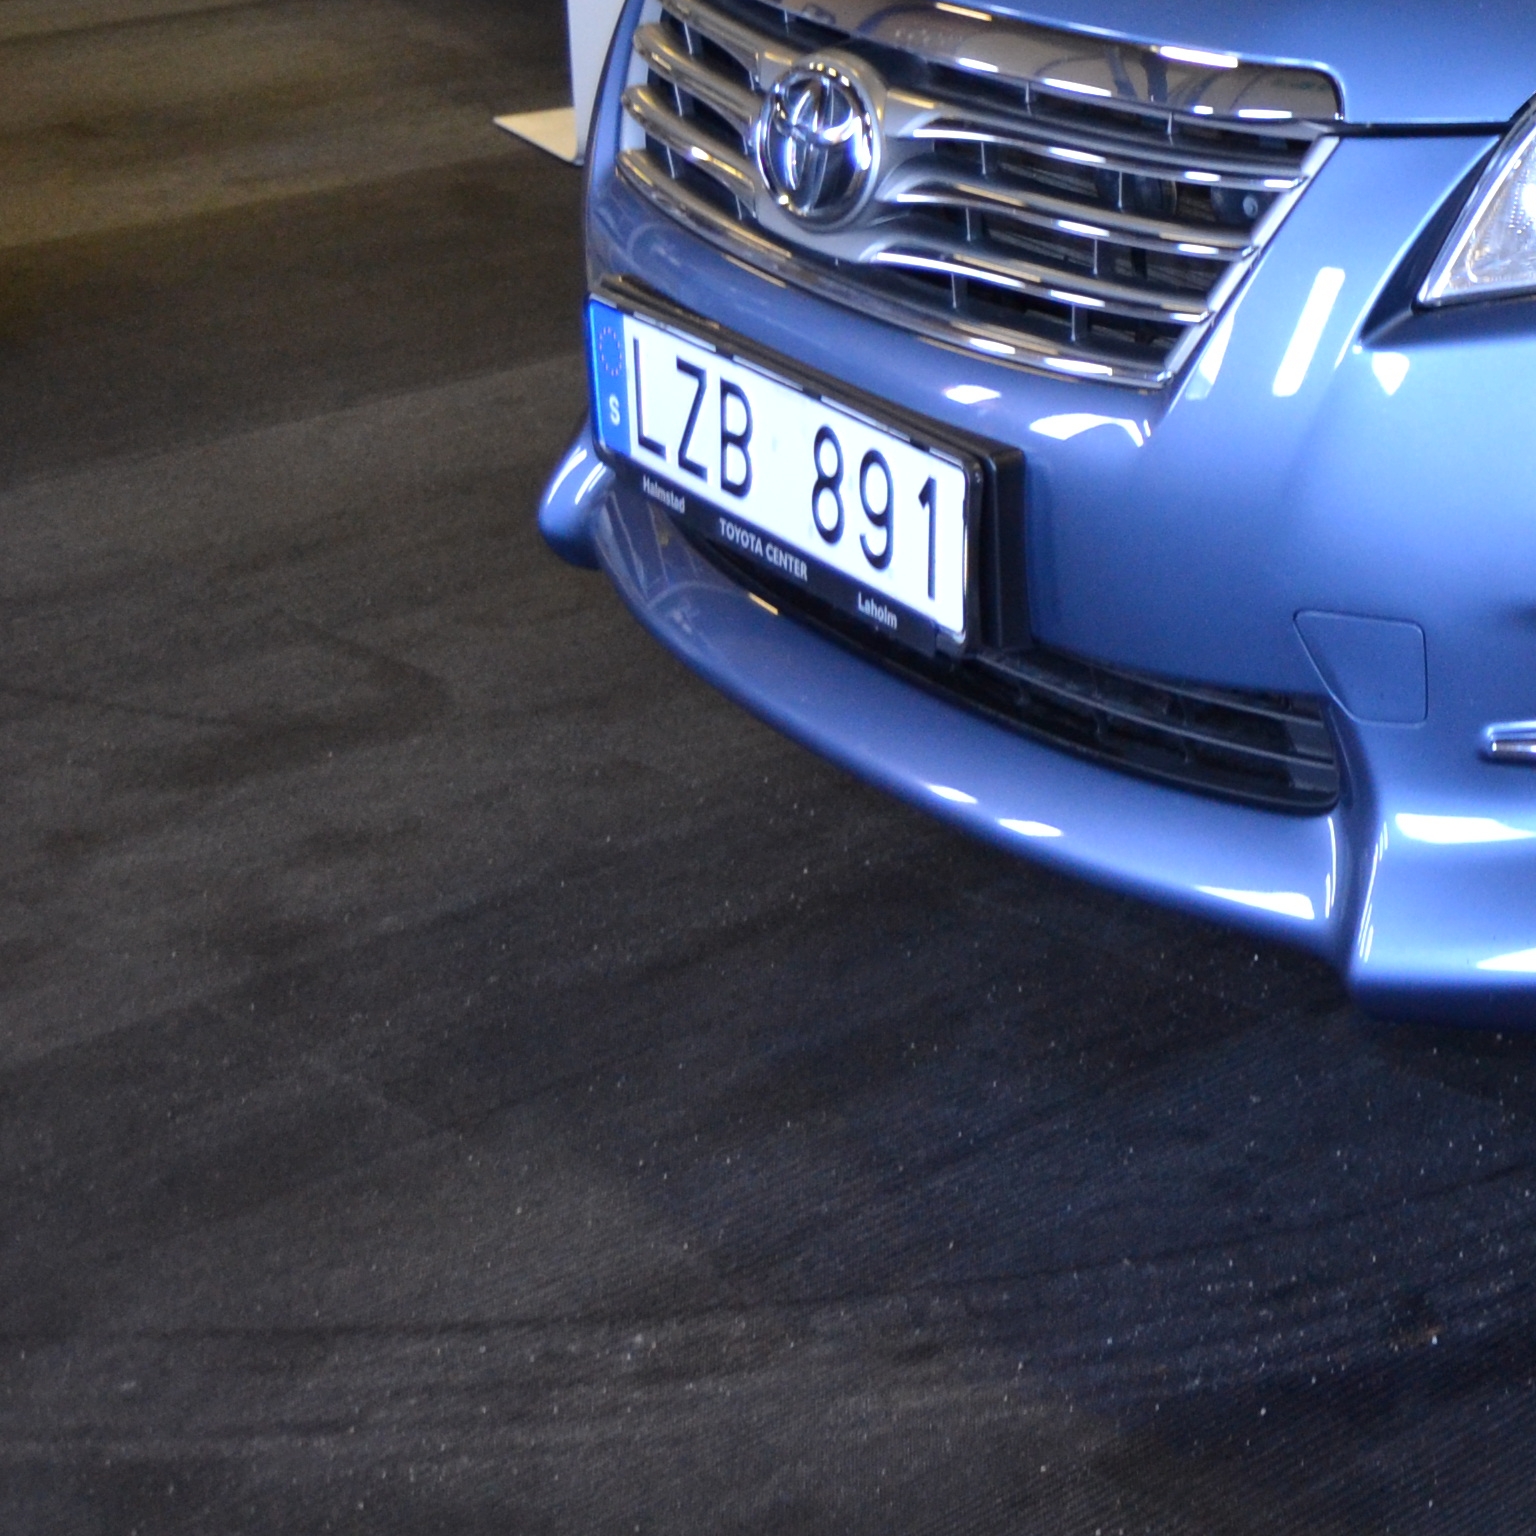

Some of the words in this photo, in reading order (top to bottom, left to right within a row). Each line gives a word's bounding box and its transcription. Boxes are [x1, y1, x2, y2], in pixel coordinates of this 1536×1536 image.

[608, 393, 622, 427] S
[632, 336, 754, 502] LZB
[811, 424, 938, 603] 891
[642, 474, 686, 514] Halmstad
[719, 517, 764, 557] TOYOTA
[765, 544, 808, 582] CENTER
[857, 591, 898, 630] Laholm
